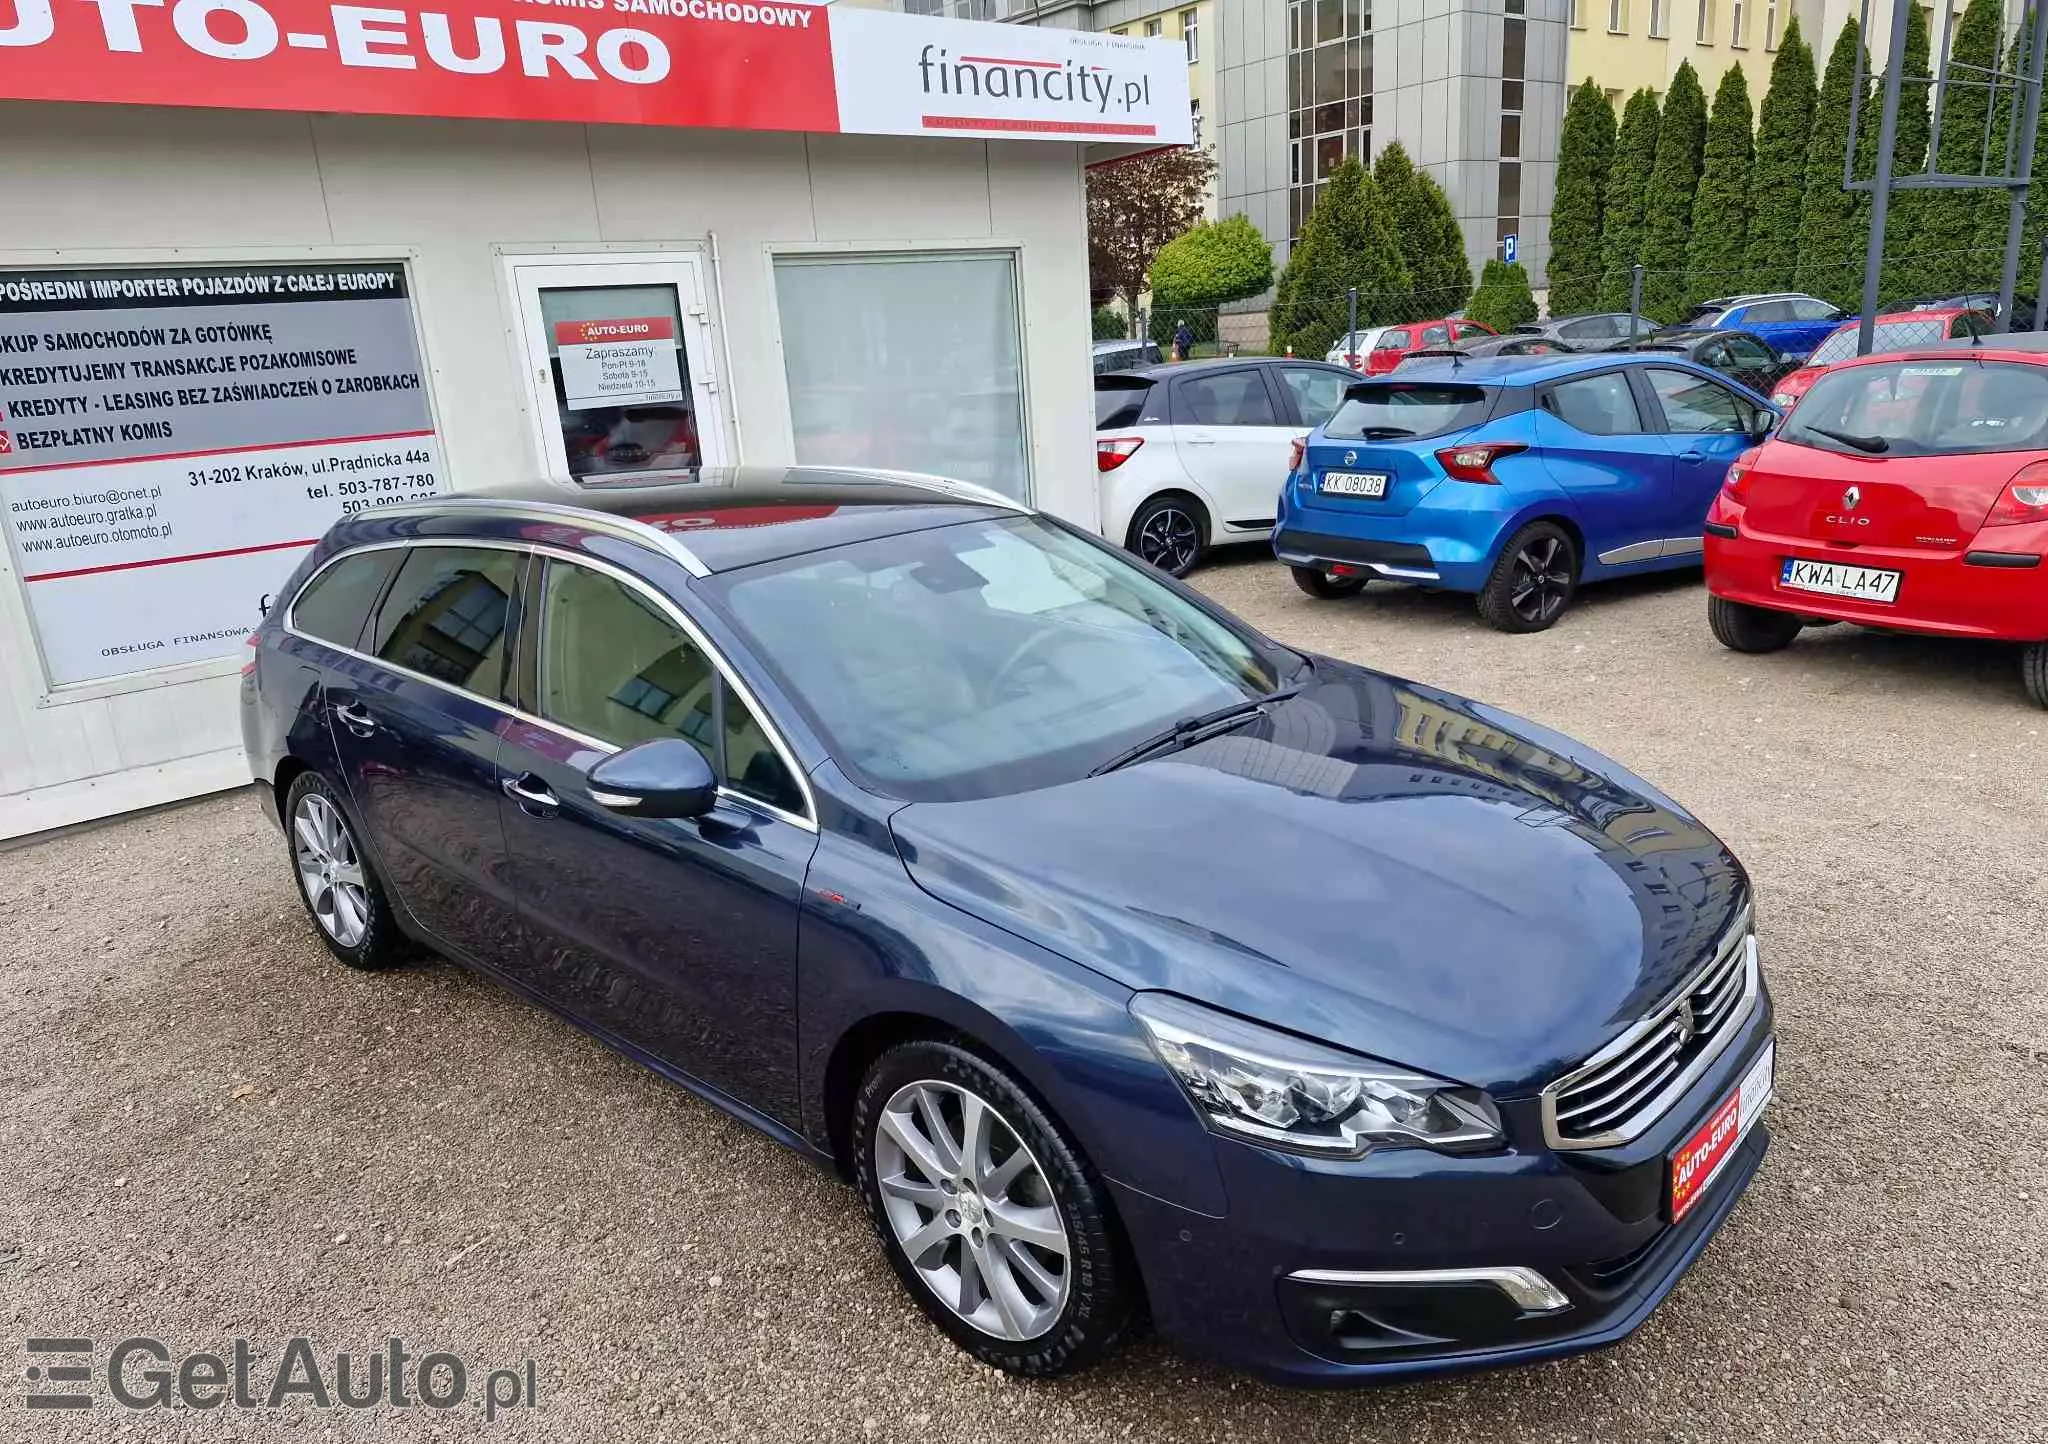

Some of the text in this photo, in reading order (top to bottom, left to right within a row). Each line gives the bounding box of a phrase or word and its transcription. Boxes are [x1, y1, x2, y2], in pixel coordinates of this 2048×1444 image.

[613, 0, 812, 28] SAMOCHODOWY
[918, 44, 1150, 114] financity.pl
[1506, 238, 1514, 260] P
[90, 279, 180, 299] IMPORTER
[183, 273, 270, 296] POJAZDÓW
[273, 275, 285, 293] Z
[287, 274, 335, 292] CAŁEJ
[339, 272, 395, 290] EUROPY
[0, 321, 273, 353] KUP SAMOCHODÓW ZA GOTÓWKĘ
[588, 323, 649, 337] AUTO-EURO
[0, 349, 357, 386] KREDYTUJEMY TRANSAKCJE POZAKOMISOWE
[8, 396, 87, 418] KREDYTY
[103, 391, 174, 412] LEASING
[177, 387, 209, 406] BEZ
[212, 376, 318, 404] ZAŚWIADCZEŃ
[322, 379, 332, 395] O
[335, 374, 420, 395] ZAROBKACH
[16, 421, 173, 450] BEZPŁATNY KOMIS
[188, 450, 430, 487] 31-202 Kraków, ul.Prądnicka 44a
[307, 473, 434, 499] tel. 503-787-780
[1327, 473, 1382, 494] KK 08038
[12, 485, 162, 513] autoeuro.biuro@onet.pl
[16, 503, 158, 532] www.autoeuro.gratka.pl
[1825, 515, 1870, 526] CLIO
[22, 522, 172, 553] www.autoeuro.otomoto.pl
[1794, 562, 1895, 594] KWA LA47
[101, 640, 165, 657] OBSŁUGA
[1679, 1107, 1737, 1185] AUTO-EURO
